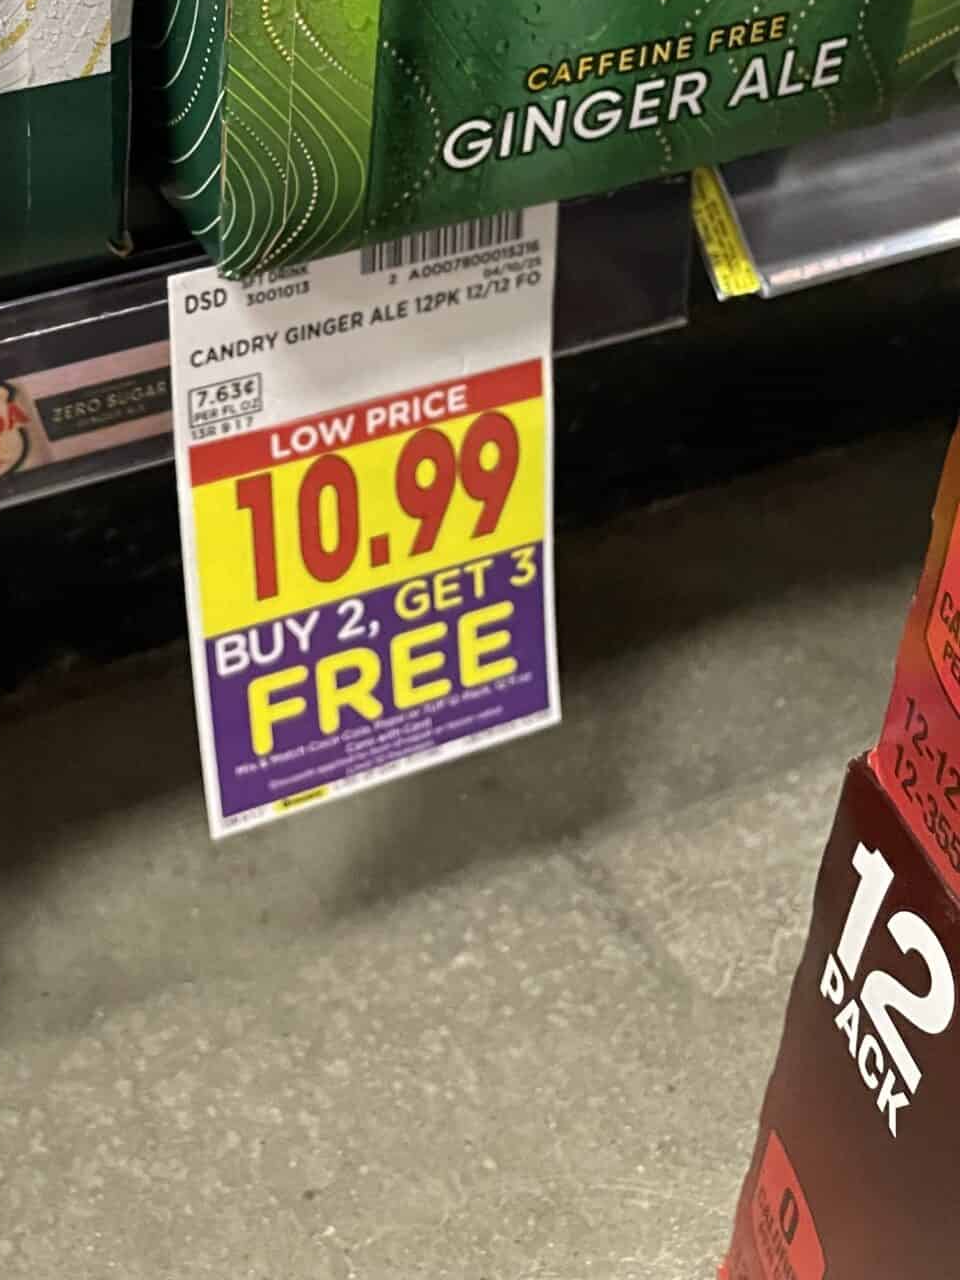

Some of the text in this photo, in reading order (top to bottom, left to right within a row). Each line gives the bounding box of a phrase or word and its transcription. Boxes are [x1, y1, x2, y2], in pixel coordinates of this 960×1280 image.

[526, 15, 788, 93] CAFFEINE FREE
[442, 36, 849, 172] GINGER ALE
[184, 287, 228, 315] DSD
[189, 271, 541, 369] CANDRY GINGER ALE 12PK 12/12 FO
[247, 281, 310, 306] 3001013
[52, 398, 102, 423] ZERO
[270, 385, 468, 459] LOW PRICE
[235, 412, 519, 602] 10.99
[214, 546, 537, 677] BUY 2, GET 3
[247, 600, 519, 756] FREE
[837, 839, 956, 1094] 12
[820, 952, 911, 1138] PACK
[779, 1187, 800, 1245] 0
